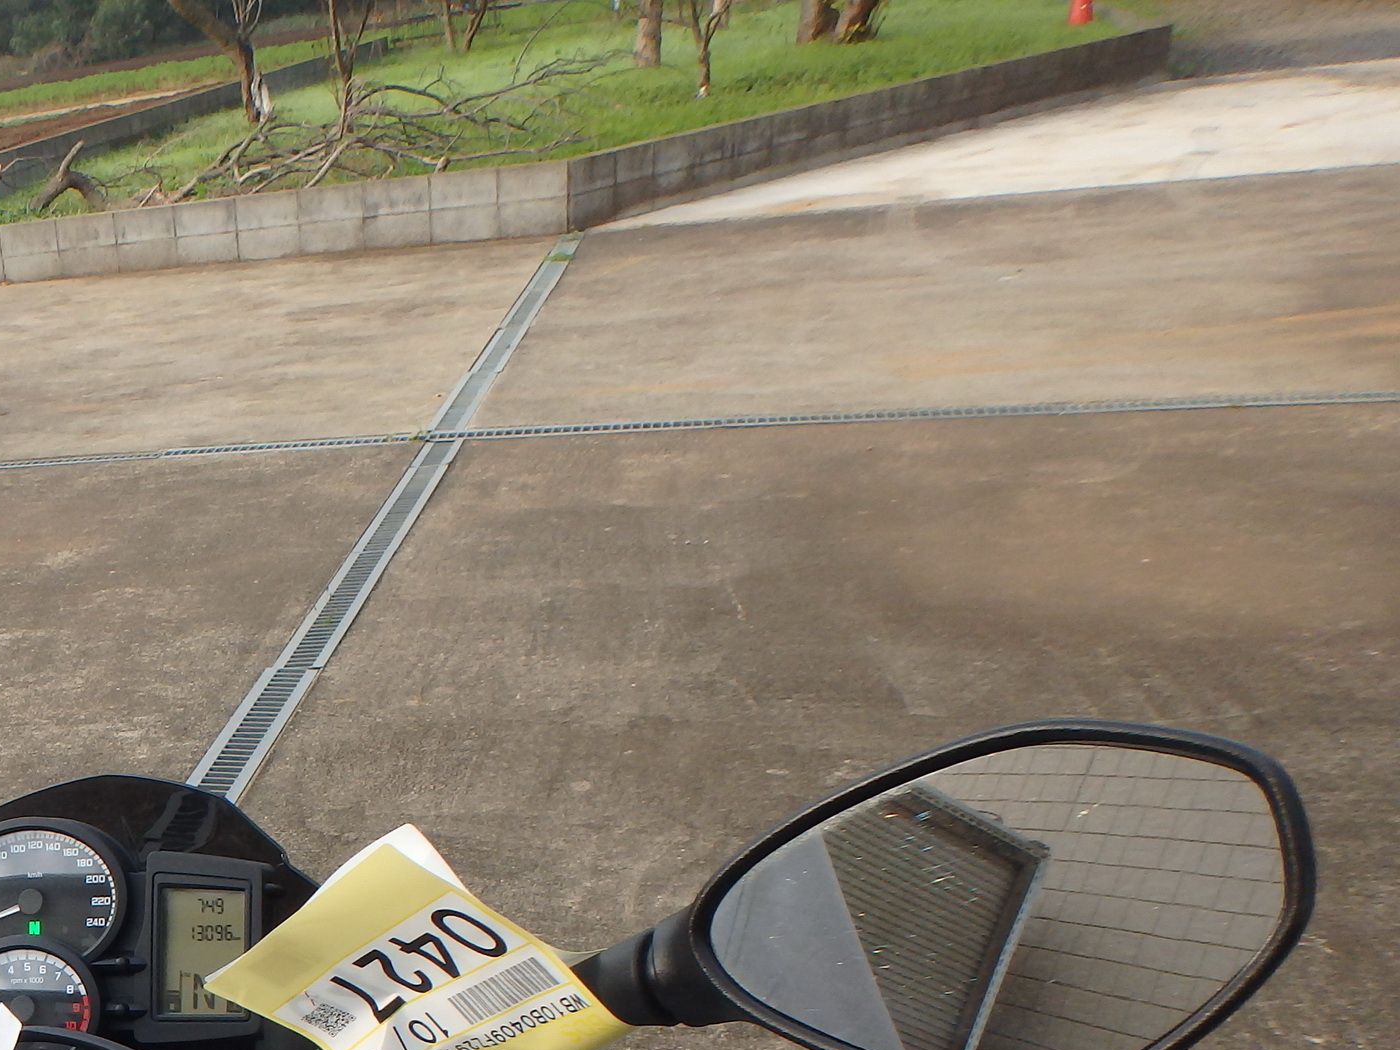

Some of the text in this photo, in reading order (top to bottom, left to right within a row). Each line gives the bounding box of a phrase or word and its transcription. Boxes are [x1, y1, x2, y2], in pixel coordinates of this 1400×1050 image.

[10, 844, 26, 853] 100
[27, 841, 43, 849] 120
[45, 842, 61, 851] 140
[63, 848, 79, 857] 160
[76, 858, 93, 867] 180
[85, 874, 106, 884] 200
[91, 897, 111, 906] 220
[86, 918, 106, 927] 240
[28, 921, 41, 935] N
[192, 925, 233, 941] 13096
[7, 965, 14, 974] 4
[24, 963, 31, 972] 5
[39, 965, 47, 974] 6
[330, 909, 508, 1024] 0427
[55, 971, 62, 981] 7
[10, 977, 23, 985] rpm
[66, 985, 74, 994] 8
[72, 1003, 80, 1013] 9
[65, 1021, 77, 1030] 10
